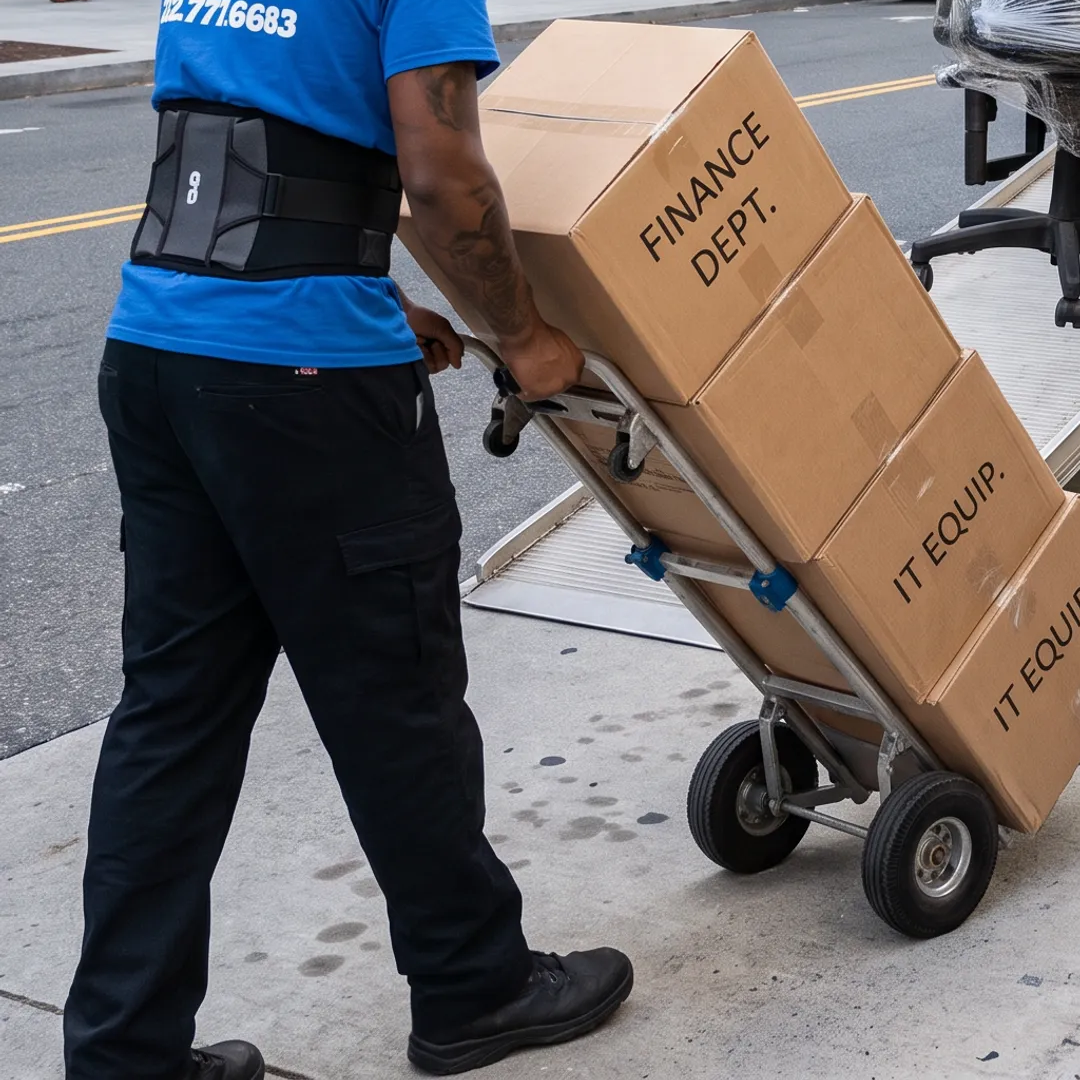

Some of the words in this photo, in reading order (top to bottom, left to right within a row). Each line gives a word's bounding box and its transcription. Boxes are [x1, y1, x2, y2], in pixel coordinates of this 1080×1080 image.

[639, 110, 770, 263] FINANCE
[690, 186, 777, 287] DEPT.
[893, 555, 923, 604] IT
[921, 461, 1005, 566] EQUIP.
[992, 683, 1020, 732] IT
